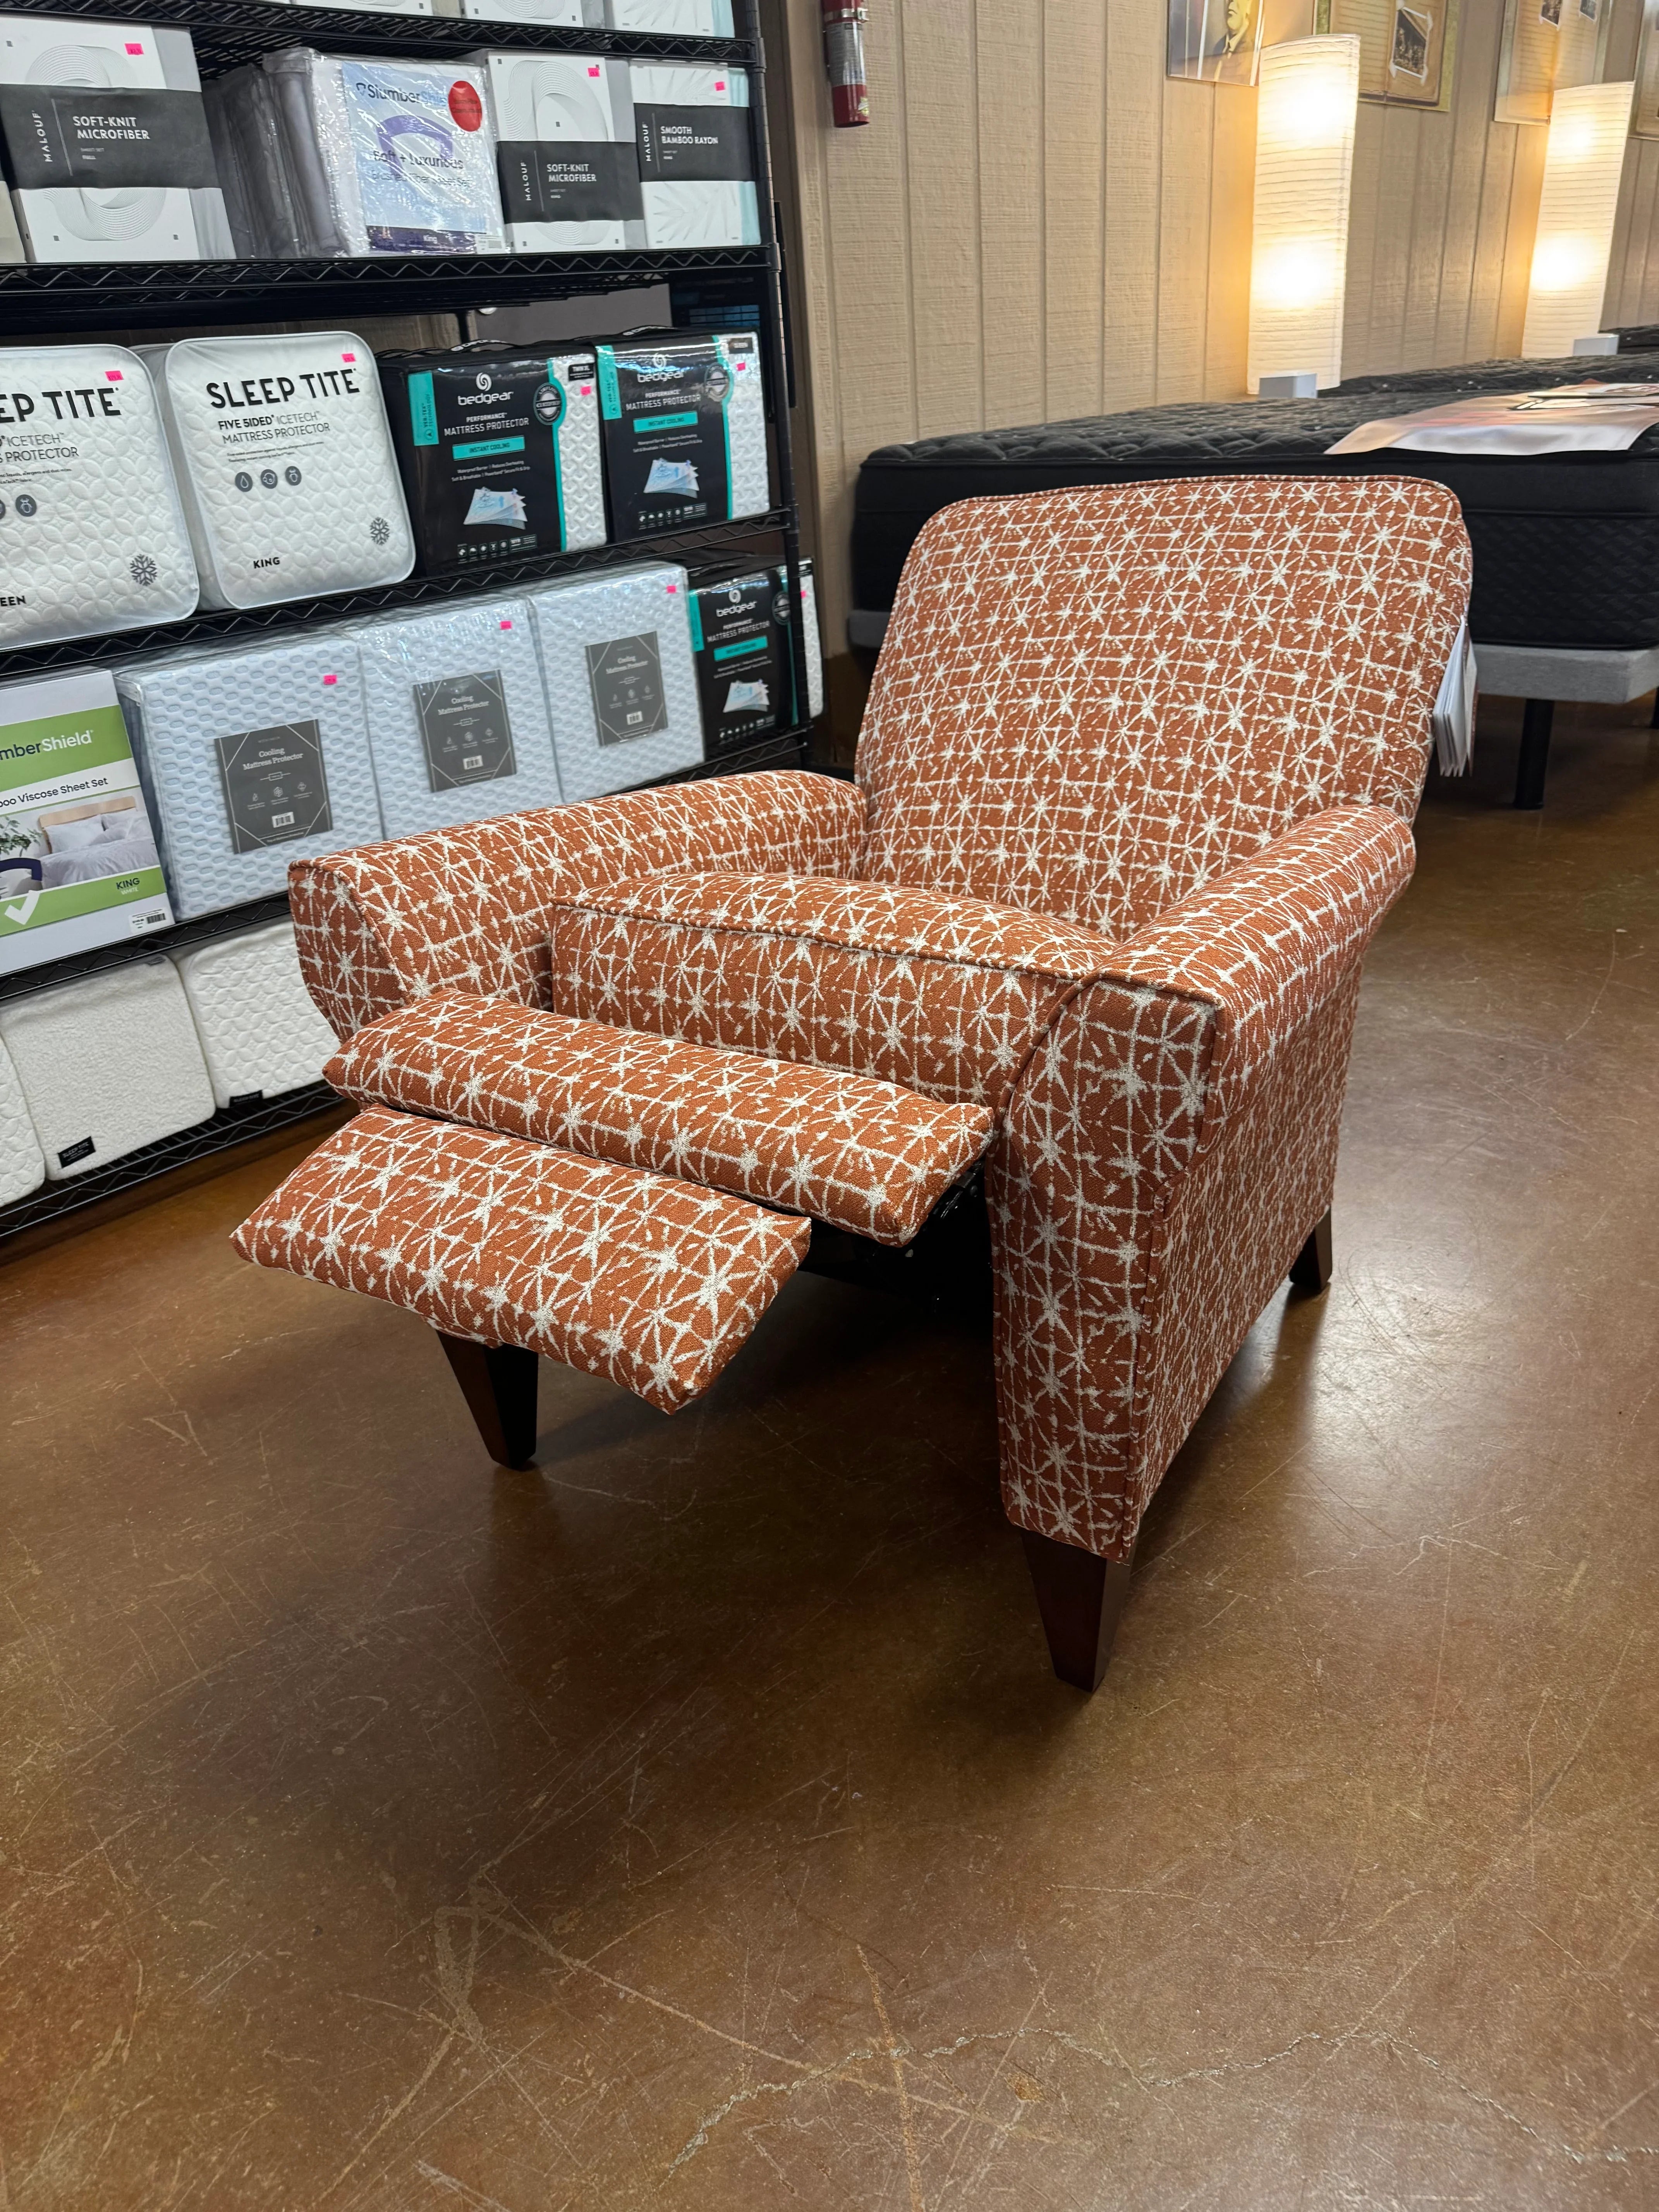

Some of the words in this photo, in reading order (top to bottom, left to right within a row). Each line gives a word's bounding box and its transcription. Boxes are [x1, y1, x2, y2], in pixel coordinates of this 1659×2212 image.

[72, 116, 137, 127] SOFT-KNIT
[32, 112, 53, 162] MALOUF
[77, 129, 151, 139] MICROFIBER
[660, 126, 692, 134] SMOOTH
[642, 124, 651, 161] MALOUF
[661, 136, 693, 144] BAMBOO
[694, 136, 718, 144] RAYON
[546, 164, 589, 172] SOFT-KNIT
[520, 162, 531, 201] MALOUF
[548, 174, 597, 182] MICROFIBER
[206, 377, 295, 409] SLEEP
[299, 369, 360, 398] TITE
[42, 387, 122, 420] TITE
[457, 391, 513, 405] bedgear
[626, 399, 662, 411] MATTRESS
[663, 394, 701, 406] PROTECTOR
[218, 420, 242, 430] FIVE
[276, 412, 319, 425] ICETECH
[466, 412, 505, 422] PERFORMANCE
[222, 430, 273, 444] MATTRESS
[275, 422, 330, 438] PROTECTOR
[444, 423, 484, 436] MATTRESS
[486, 417, 529, 430] PROTECTOR
[7, 433, 61, 447] ICETECH
[469, 445, 489, 453] INSTANT
[490, 442, 510, 450] COOLING
[5, 447, 79, 462] PROTECTOR
[253, 557, 280, 569] KING
[716, 601, 757, 617] bedgear
[707, 629, 737, 643] MATTRESS
[737, 621, 770, 635] PROTECTOR
[259, 748, 285, 757] Cooling
[242, 759, 272, 770] Mattress
[272, 753, 304, 764] Protector
[18, 789, 58, 802] Viscose
[60, 781, 90, 793] Sheet
[91, 778, 108, 787] Set
[116, 878, 140, 890] KING
